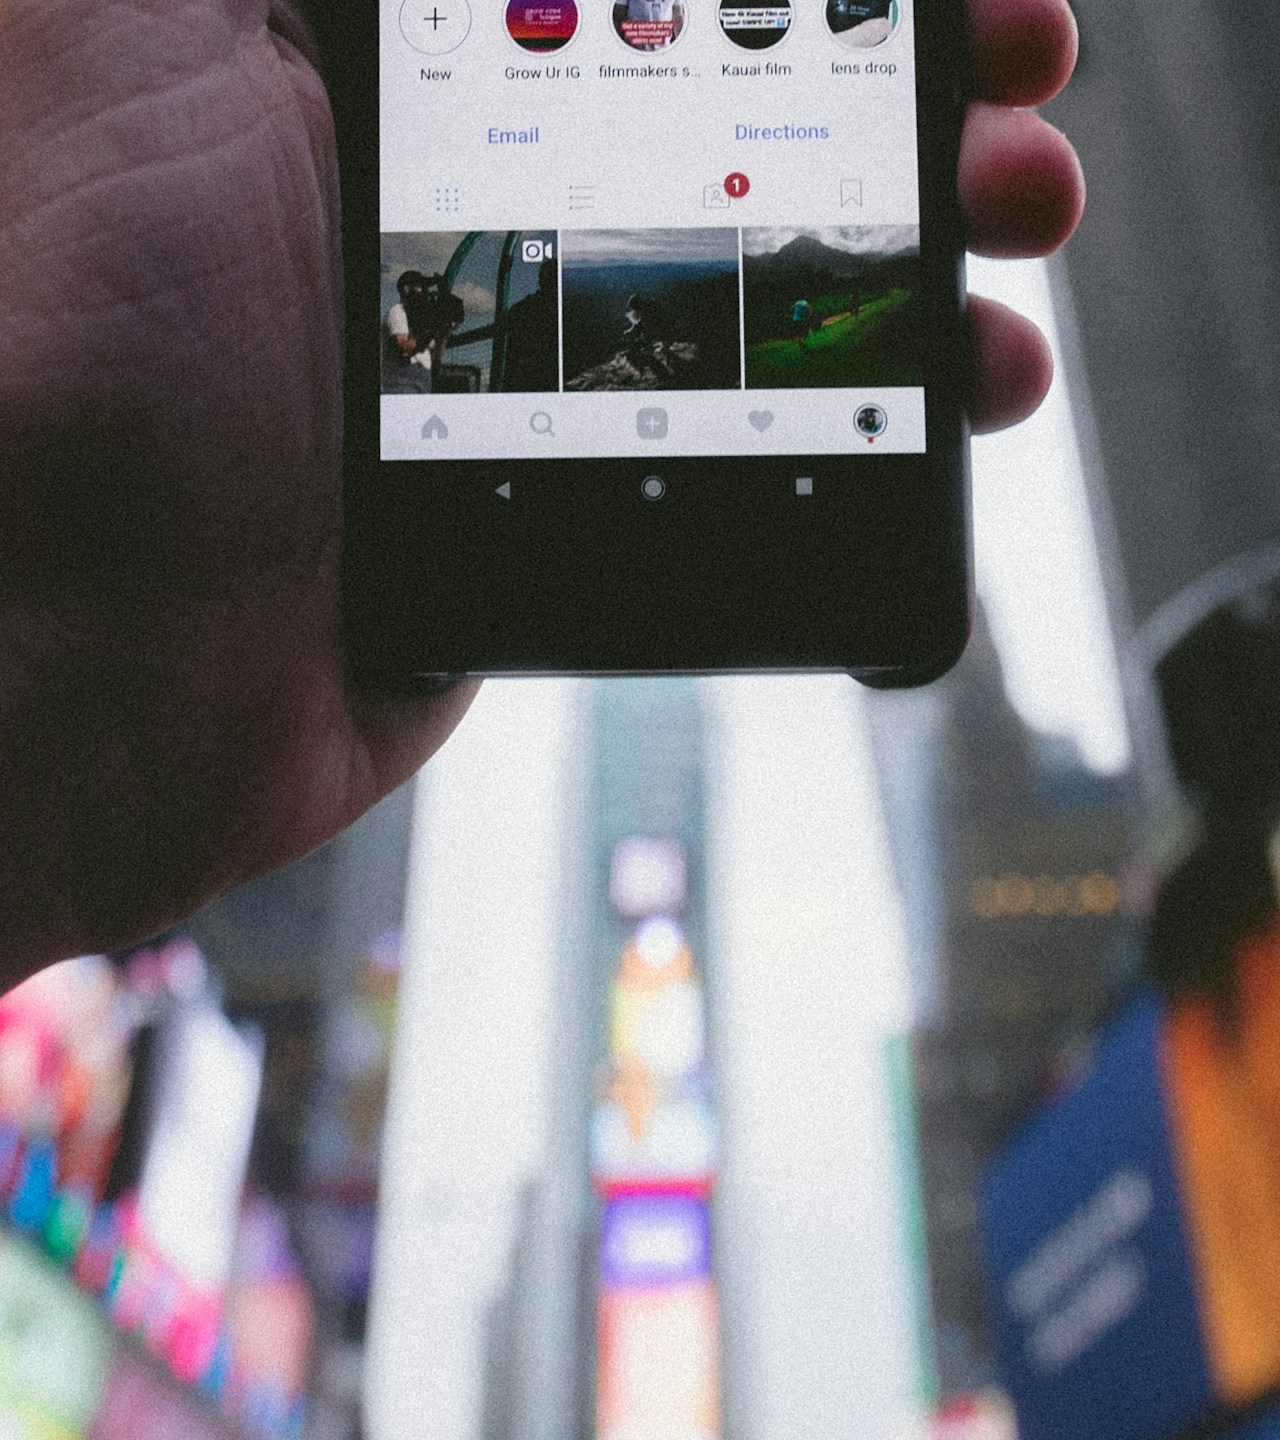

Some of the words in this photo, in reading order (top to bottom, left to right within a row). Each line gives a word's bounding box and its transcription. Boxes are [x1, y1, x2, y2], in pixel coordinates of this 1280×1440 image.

[420, 67, 453, 82] New
[504, 66, 542, 81] Grow
[545, 66, 562, 80] Ur
[565, 65, 582, 80] IG
[598, 64, 678, 79] filmmakers
[721, 63, 761, 77] Kauai
[764, 61, 793, 76] film
[831, 61, 860, 75] lens
[864, 61, 898, 77] drop
[487, 125, 540, 144] Email
[734, 122, 831, 142] Directions
[732, 178, 741, 193] 1
